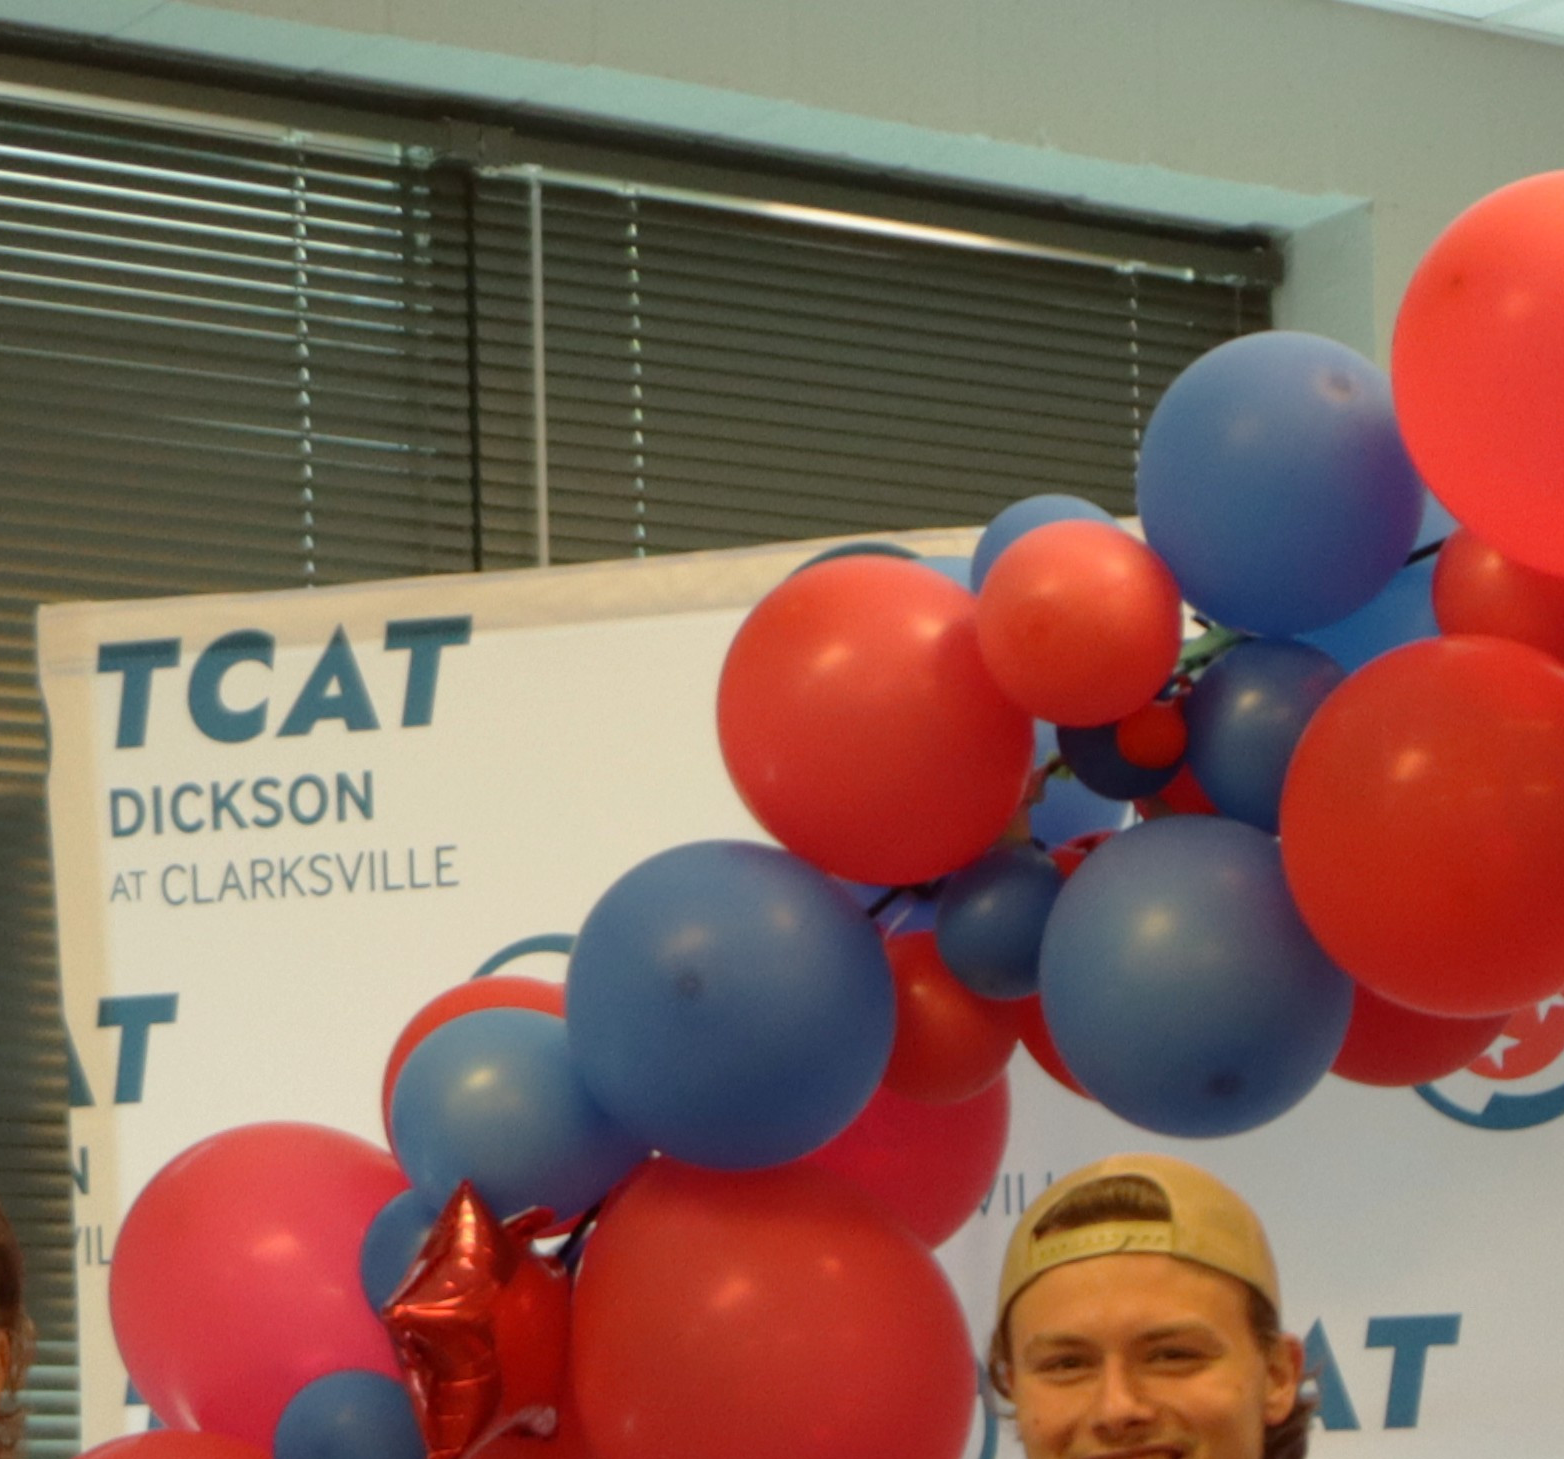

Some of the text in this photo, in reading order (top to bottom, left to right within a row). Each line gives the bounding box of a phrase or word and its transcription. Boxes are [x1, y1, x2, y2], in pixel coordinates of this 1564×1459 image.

[97, 616, 473, 749] TCAT
[109, 770, 375, 838] DICKSON
[109, 845, 461, 907] AT CLARKSVILLE
